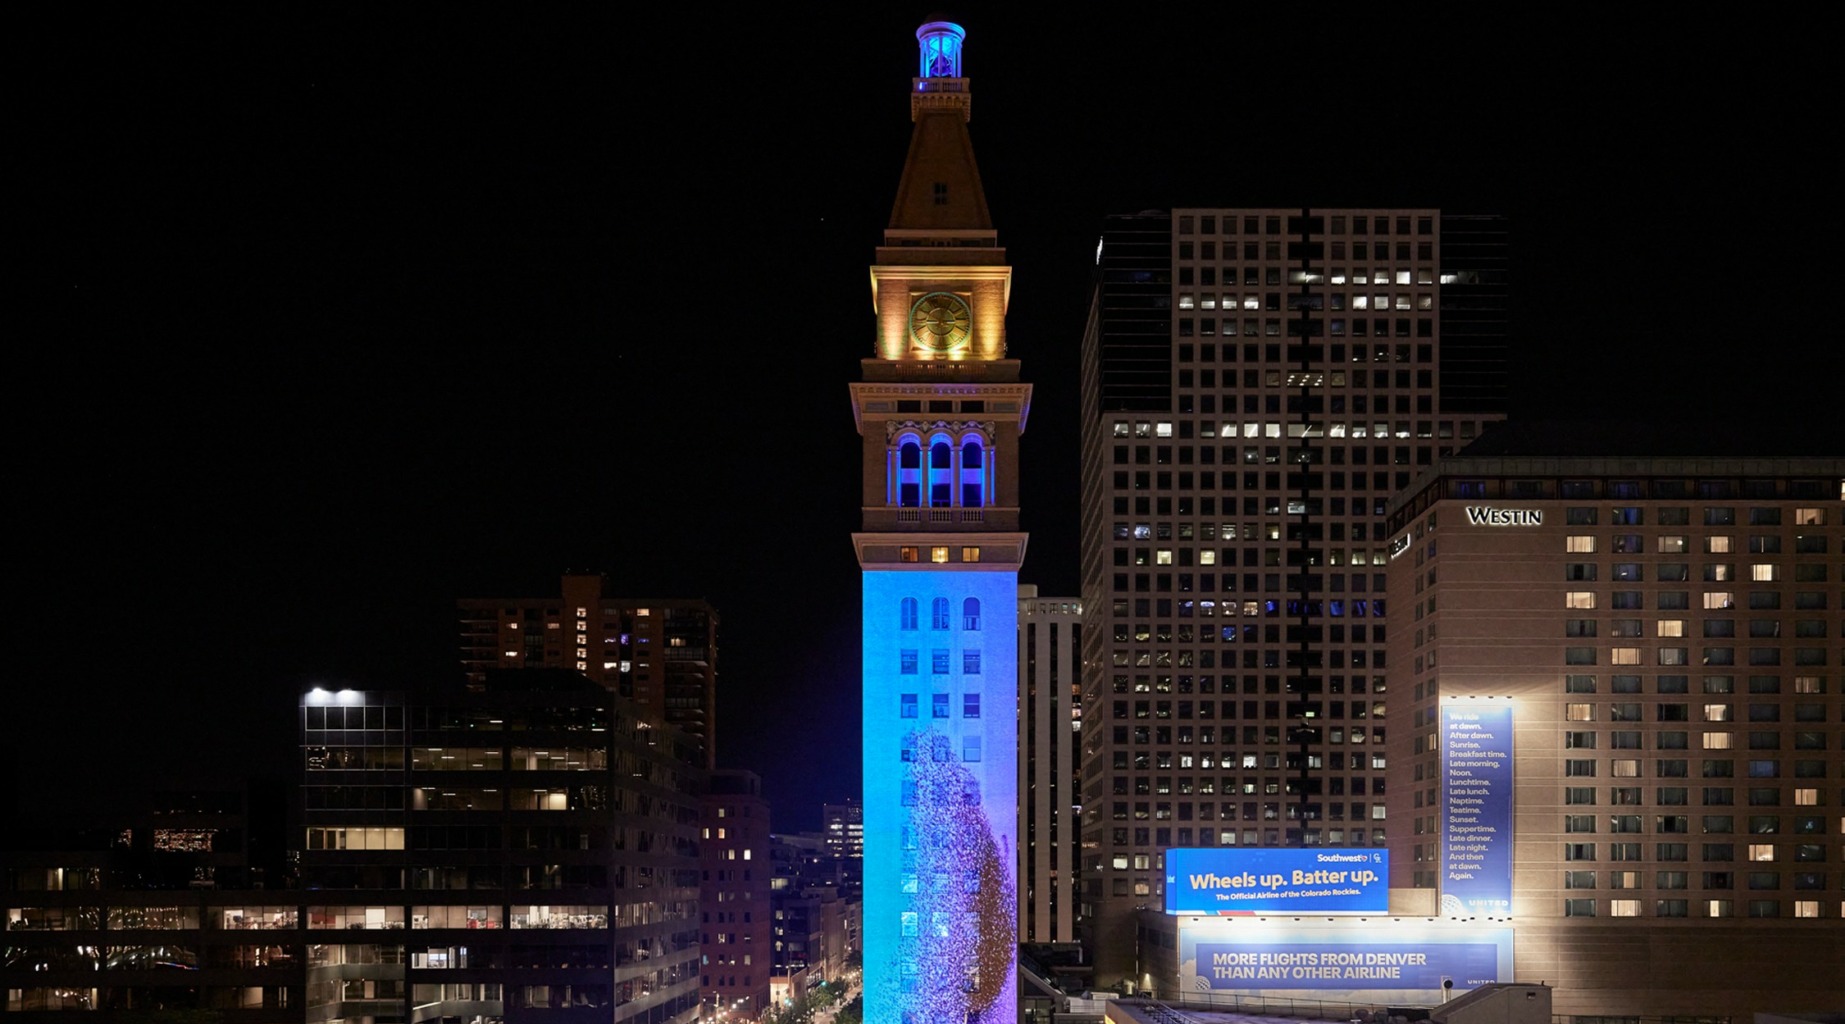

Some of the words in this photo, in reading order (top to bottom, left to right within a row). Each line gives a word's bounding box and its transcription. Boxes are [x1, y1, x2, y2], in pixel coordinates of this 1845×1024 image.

[1466, 506, 1542, 525] WESTIN
[1460, 722, 1482, 730] dawn.
[1449, 760, 1466, 768] Late
[1466, 760, 1500, 769] morning.
[1449, 769, 1472, 777] Noon.
[1449, 778, 1491, 786] Lunchtime.
[1449, 797, 1485, 806] Naptime.
[1449, 825, 1496, 834] Suppertime.
[1449, 834, 1466, 842] Late
[1466, 834, 1493, 842] dinner.
[1466, 844, 1489, 852] night.
[1317, 853, 1362, 862] Southwest
[1458, 862, 1482, 870] dawn.
[1190, 872, 1257, 890] Wheels
[1260, 874, 1288, 891] up.
[1292, 869, 1348, 886] Batter
[1350, 870, 1379, 886] up.
[1449, 872, 1474, 881] Again.
[1256, 891, 1280, 899] Airline
[1288, 890, 1300, 898] the
[1300, 889, 1332, 897] Colorado
[1332, 888, 1361, 896] Rockies.
[1213, 953, 1258, 966] MORE
[1260, 953, 1318, 966] FLIGHTS
[1320, 953, 1365, 966] FROM
[1366, 953, 1427, 966] DENVER
[1213, 966, 1256, 979] THAN
[1257, 966, 1290, 979] ANY
[1292, 966, 1342, 979] OTHER
[1343, 966, 1401, 979] AIRLINE
